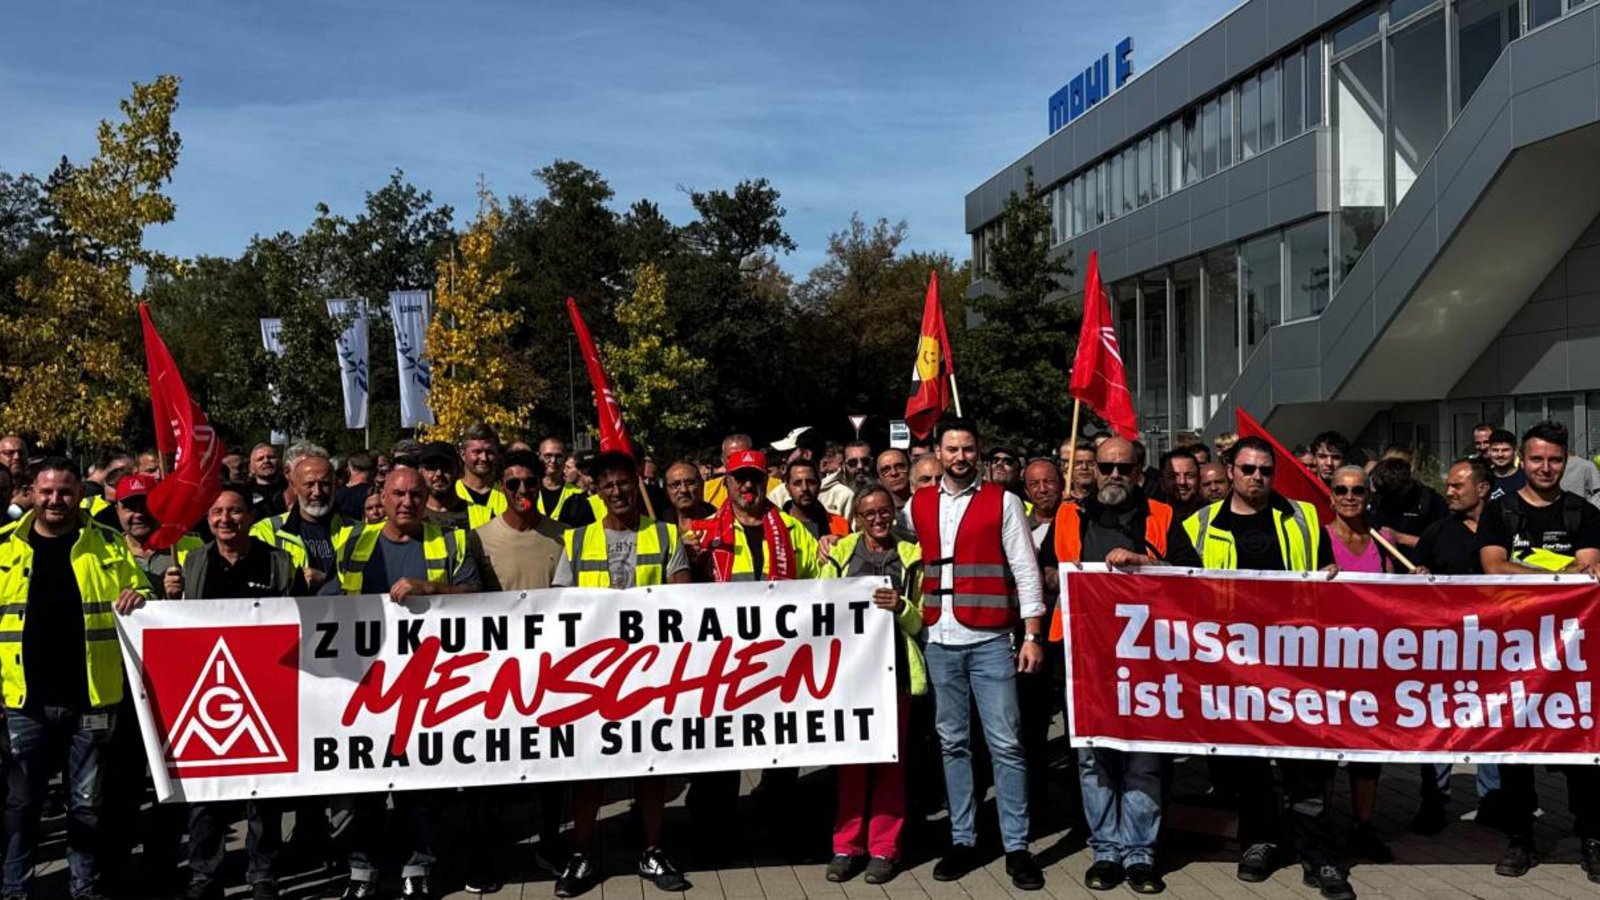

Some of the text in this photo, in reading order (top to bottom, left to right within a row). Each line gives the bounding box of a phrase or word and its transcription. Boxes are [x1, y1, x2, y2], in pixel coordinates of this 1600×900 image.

[314, 600, 870, 659] ZUKUNFT BRAUCHT
[1115, 603, 1588, 672] Zusammenhalt
[342, 636, 841, 756] MENSCHEN
[1117, 666, 1594, 730] ist unsere Stärke!
[314, 708, 875, 772] BRAUCHEN SICHERHEIT
